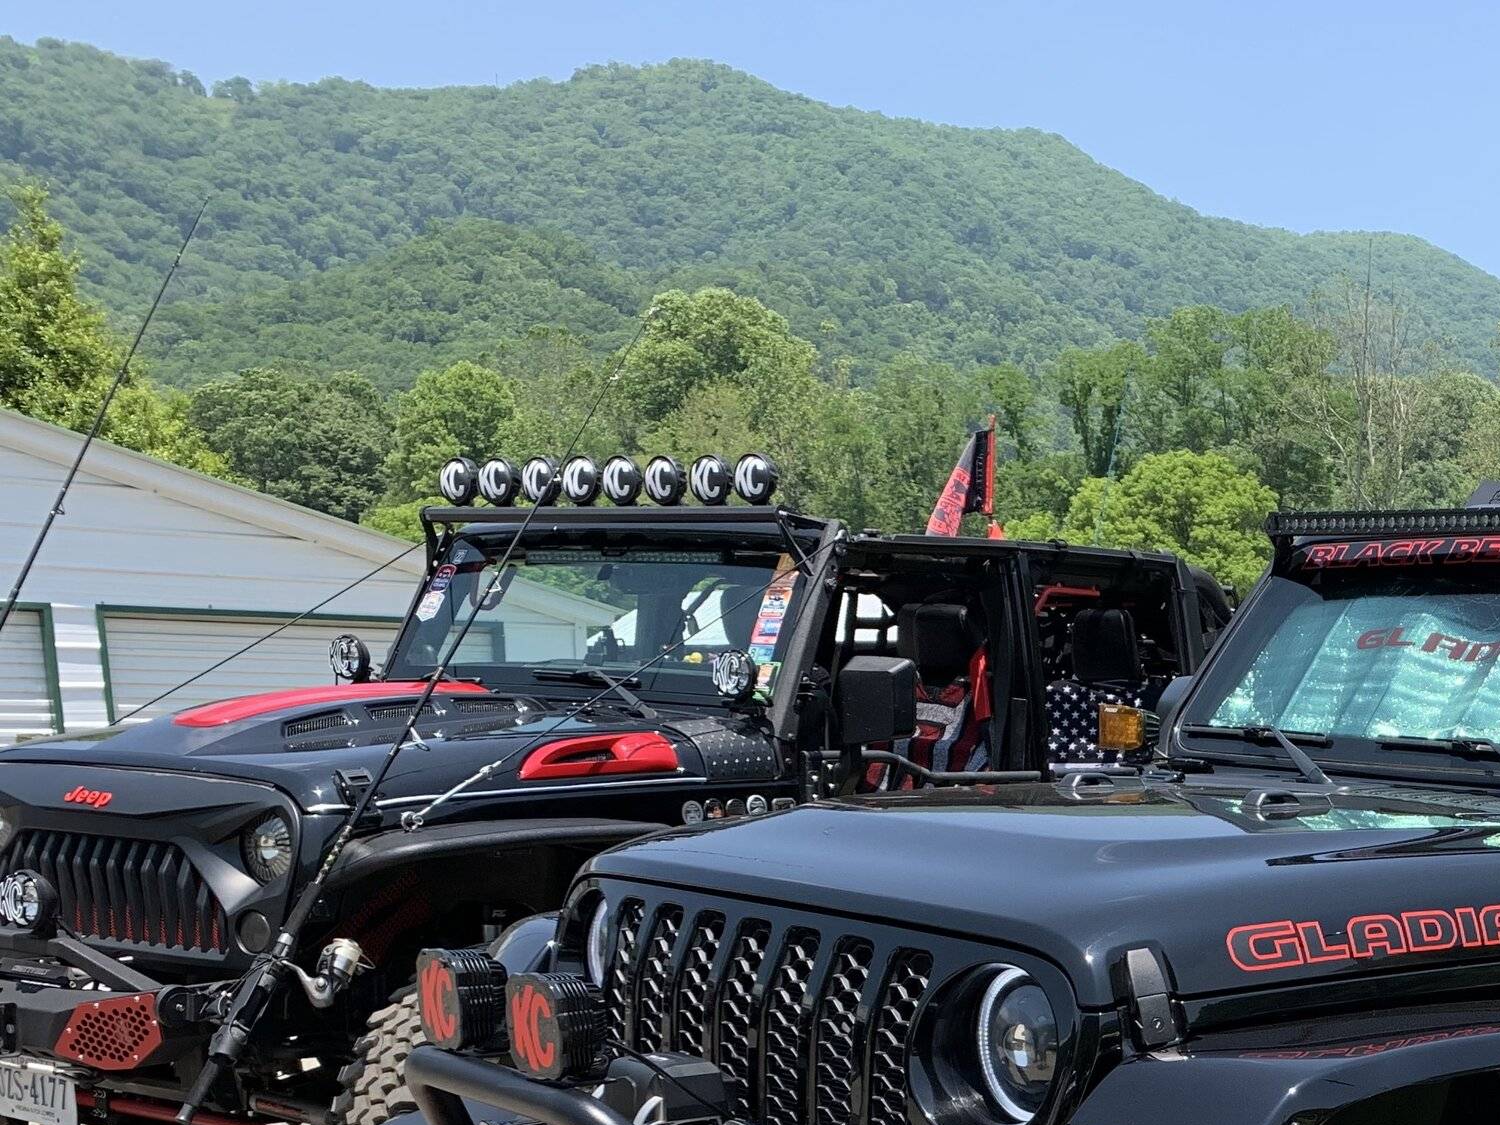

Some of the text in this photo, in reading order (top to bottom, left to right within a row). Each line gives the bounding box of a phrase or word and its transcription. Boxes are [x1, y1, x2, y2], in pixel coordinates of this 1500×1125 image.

[440, 458, 465, 498] KC
[478, 458, 506, 498] KC
[522, 458, 549, 499] KC
[563, 457, 588, 498] KC
[603, 458, 631, 498] KC
[644, 458, 671, 498] KC
[691, 458, 720, 500] KC
[735, 456, 764, 498] KC
[1303, 540, 1447, 570] BLACK
[327, 640, 353, 677] KC
[712, 652, 740, 696] KC
[64, 785, 113, 809] Jeep
[422, 959, 456, 1041] KC
[512, 984, 555, 1072] KC
